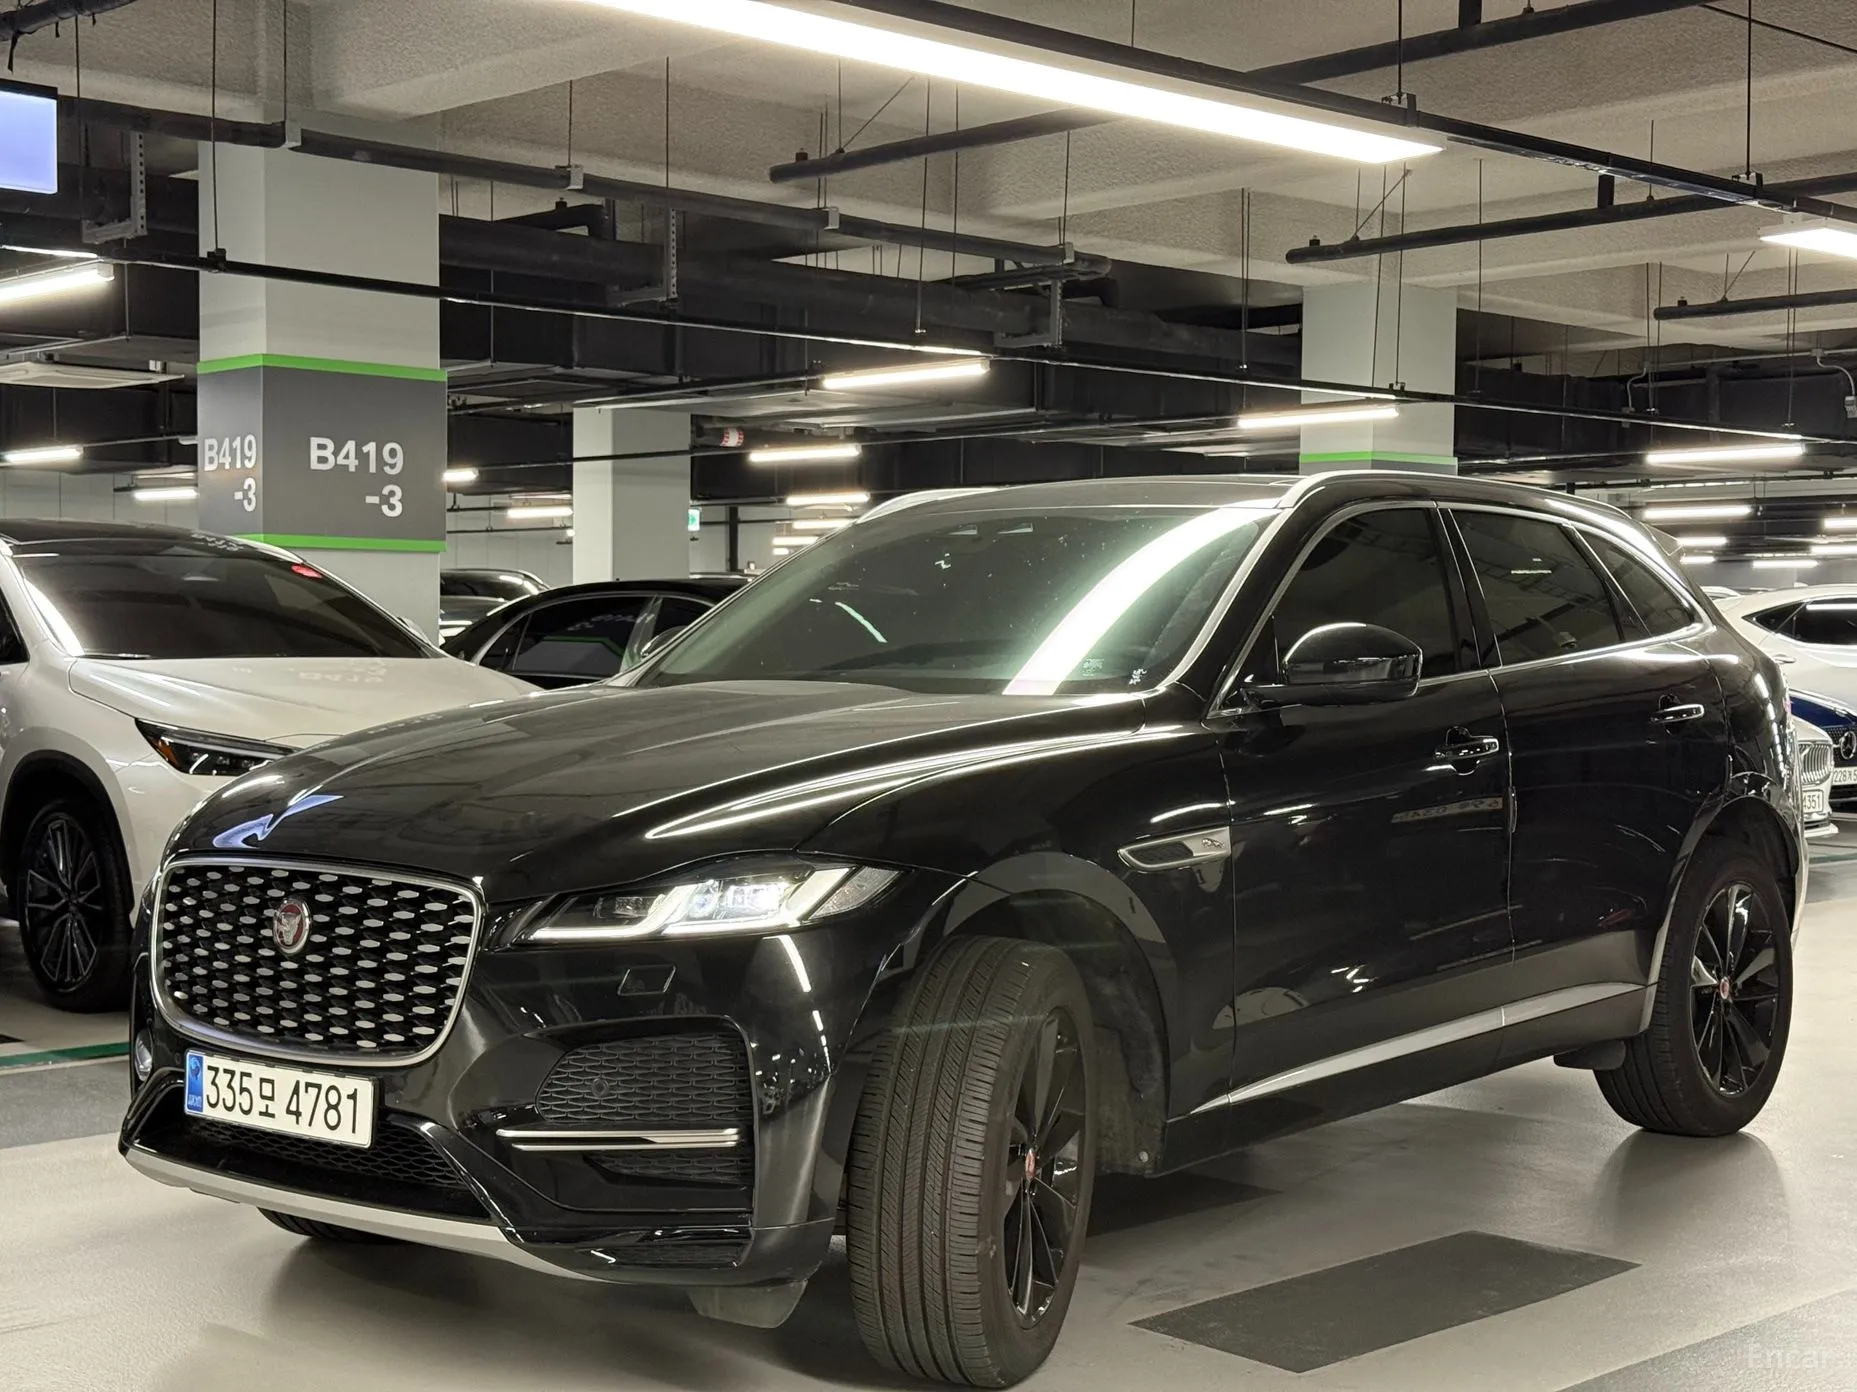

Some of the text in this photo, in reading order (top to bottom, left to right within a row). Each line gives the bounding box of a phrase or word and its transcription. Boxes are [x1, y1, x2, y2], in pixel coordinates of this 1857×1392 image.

[203, 434, 257, 472] B419
[309, 436, 404, 476] B419
[234, 477, 257, 512] -3
[365, 484, 403, 518] -3
[206, 1064, 358, 1135] 335모 4781
